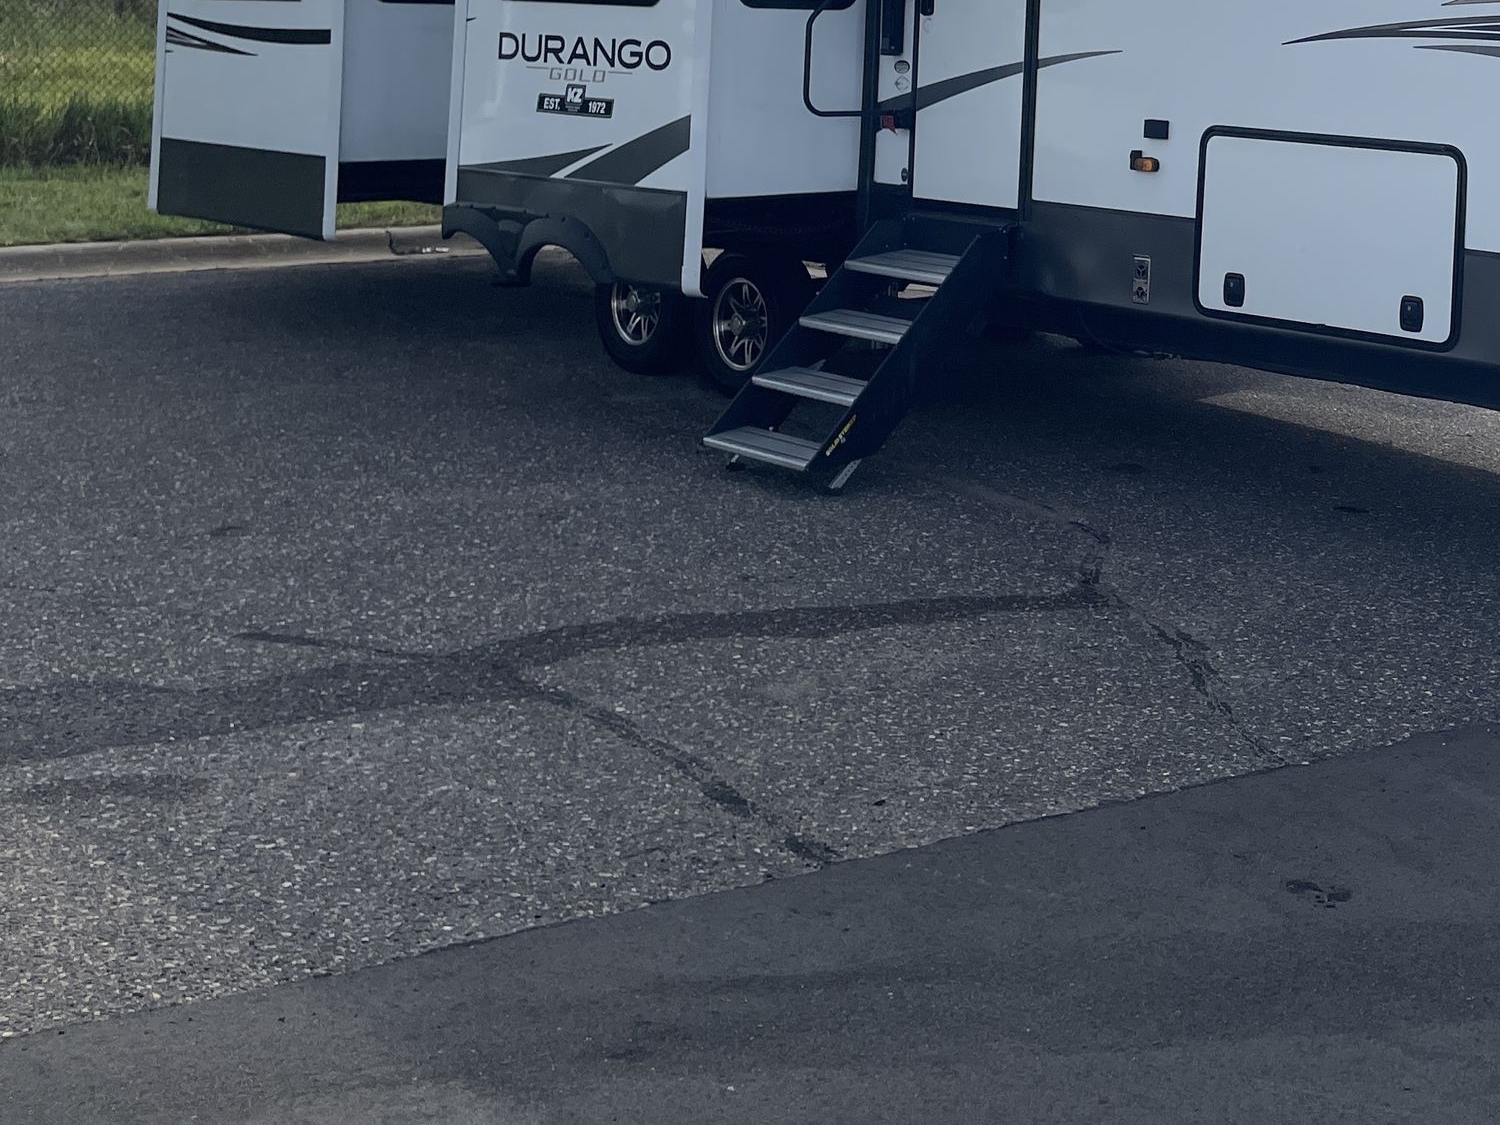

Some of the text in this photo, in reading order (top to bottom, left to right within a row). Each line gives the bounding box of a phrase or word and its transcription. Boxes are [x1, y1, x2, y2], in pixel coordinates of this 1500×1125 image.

[497, 31, 672, 71] DURANGO
[549, 67, 606, 83] GOLD
[566, 87, 583, 103] KZ
[543, 97, 561, 111] EST.
[588, 101, 606, 114] 1972
